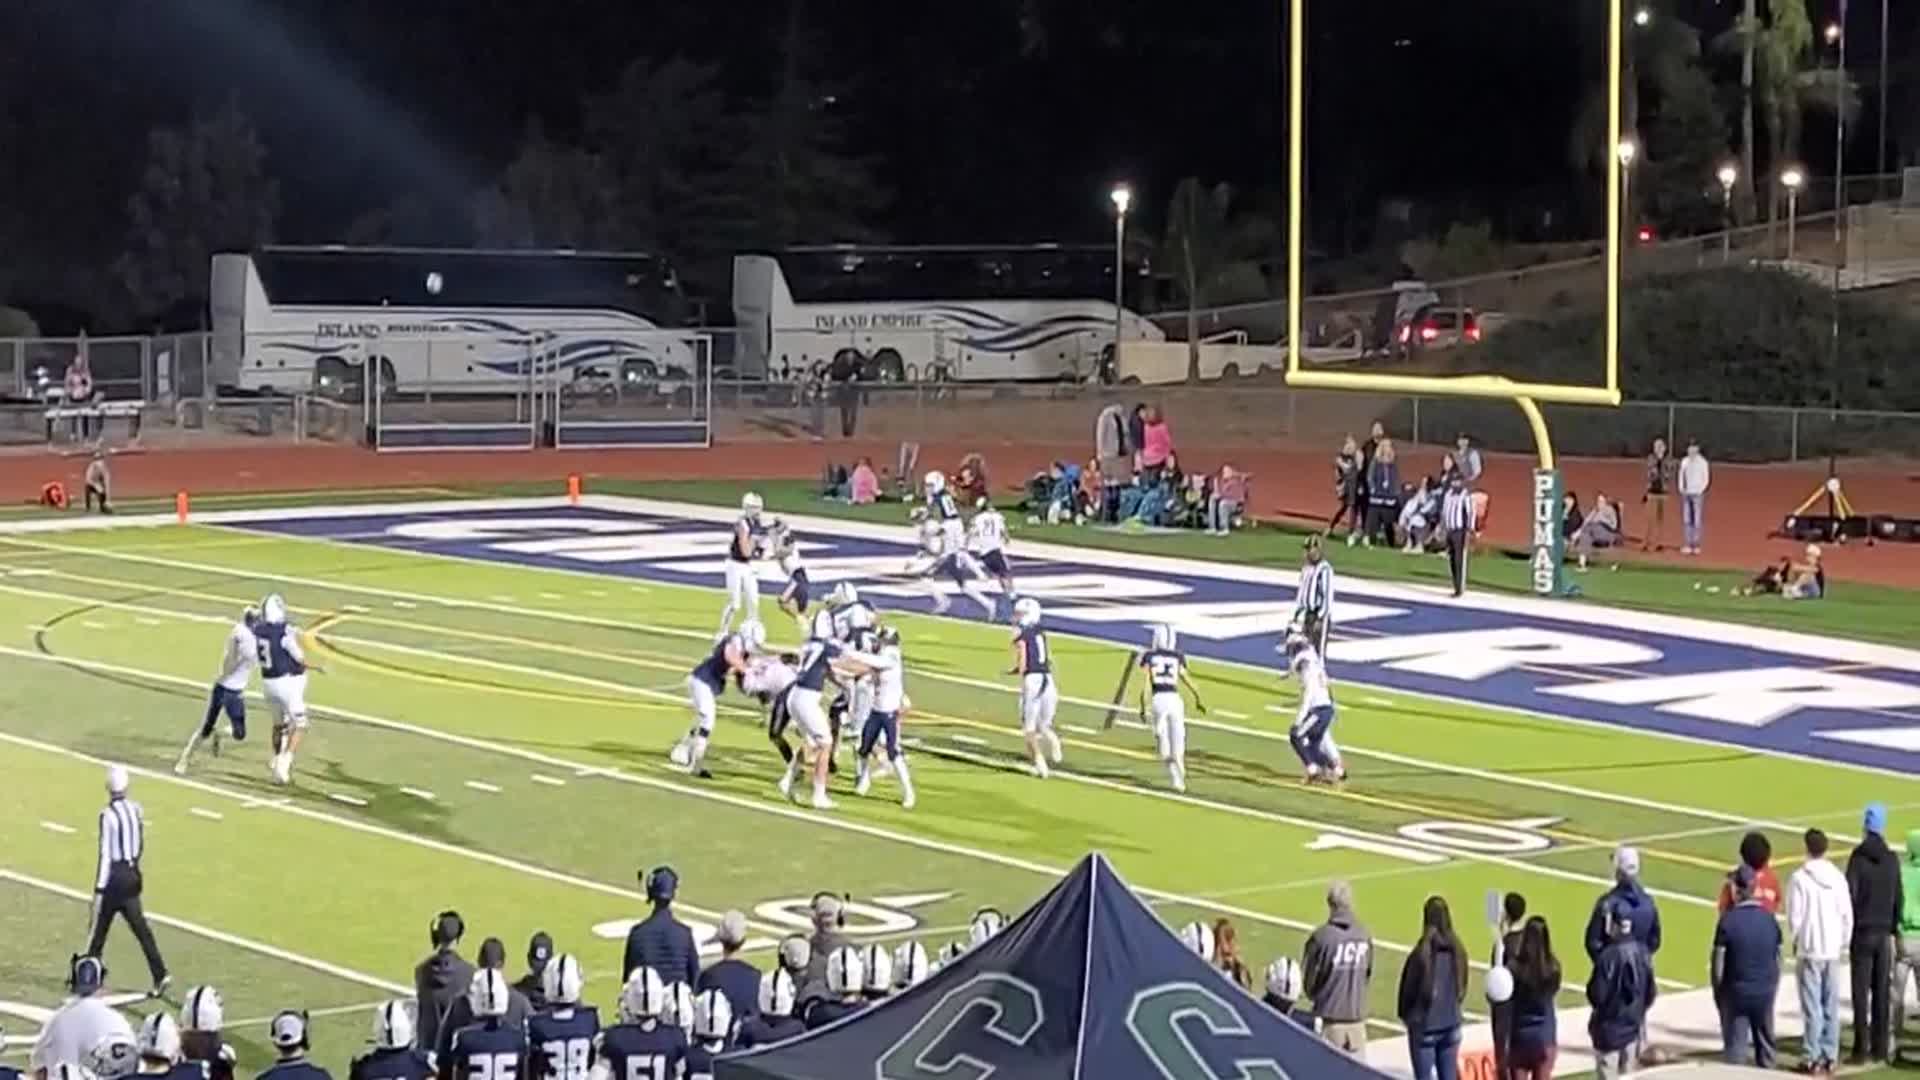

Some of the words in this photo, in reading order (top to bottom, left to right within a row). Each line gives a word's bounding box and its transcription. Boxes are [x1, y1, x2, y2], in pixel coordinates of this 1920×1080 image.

[816, 314, 868, 328] INLAND
[871, 314, 923, 328] EMPIRE
[1534, 473, 1554, 592] PUMAS
[1303, 820, 1552, 864] 10
[542, 1037, 591, 1080] 38
[876, 972, 1044, 1080] C
[1126, 982, 1293, 1080] C
